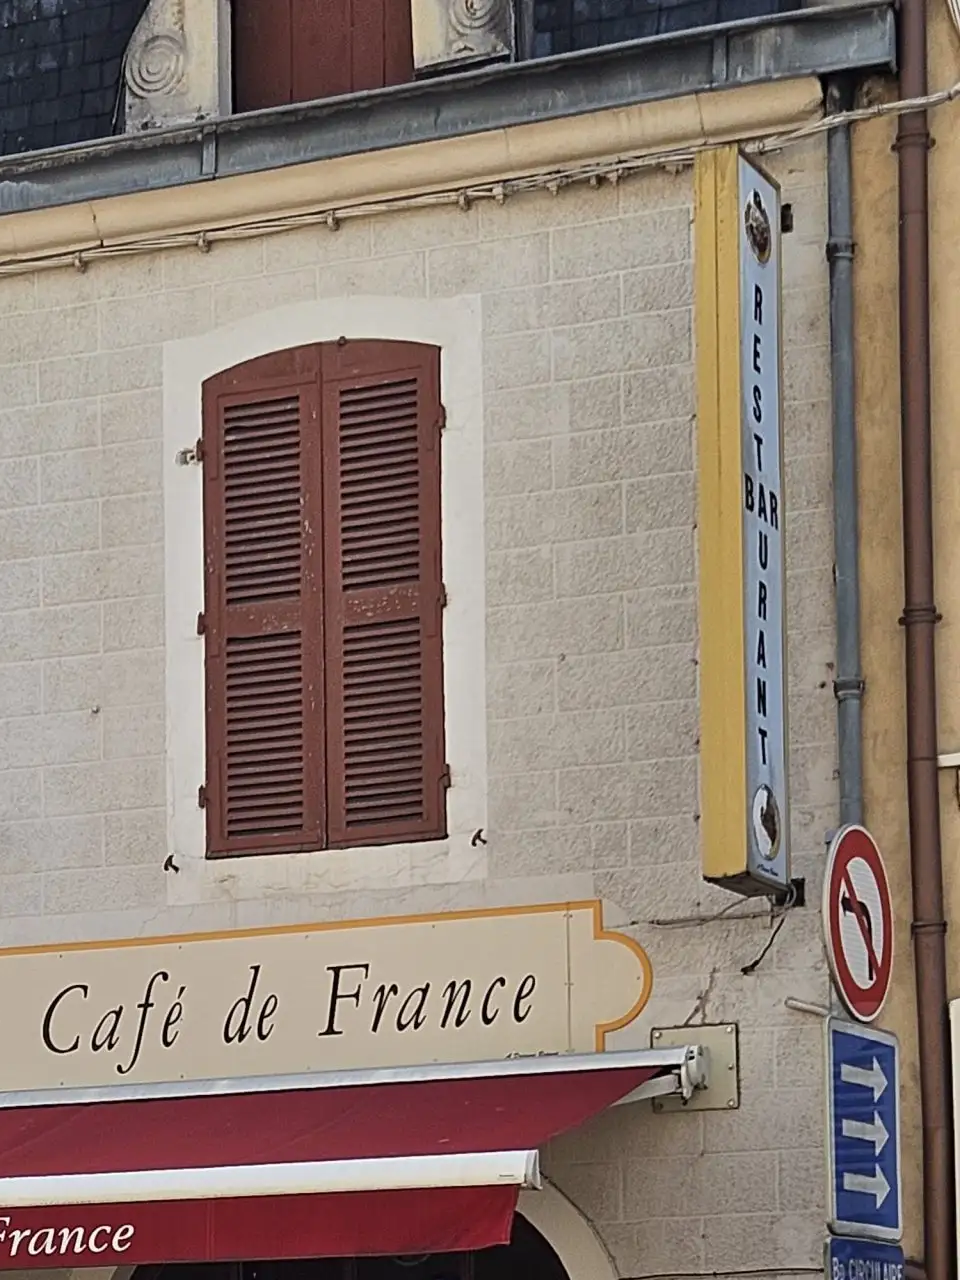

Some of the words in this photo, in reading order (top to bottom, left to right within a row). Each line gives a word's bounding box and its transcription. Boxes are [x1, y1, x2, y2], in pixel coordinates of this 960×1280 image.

[744, 473, 779, 531] BAR
[752, 283, 769, 766] RESTAURANT
[41, 970, 187, 1075] Café
[223, 965, 280, 1046] de
[318, 962, 538, 1037] France
